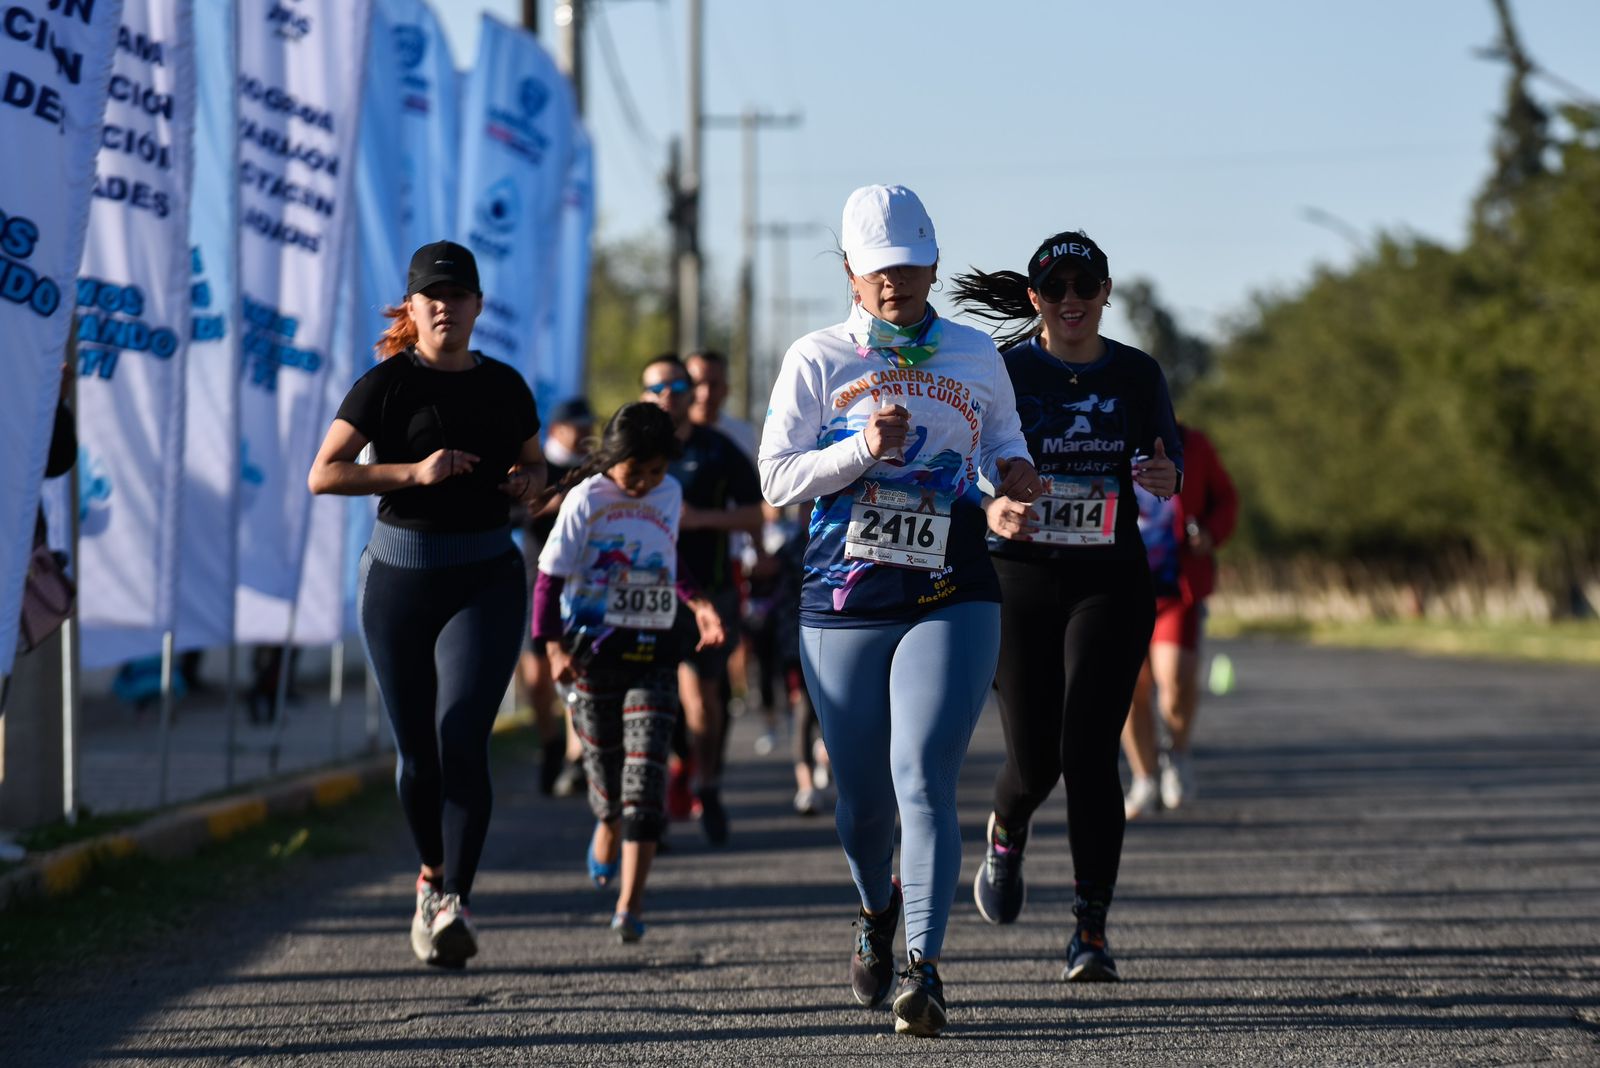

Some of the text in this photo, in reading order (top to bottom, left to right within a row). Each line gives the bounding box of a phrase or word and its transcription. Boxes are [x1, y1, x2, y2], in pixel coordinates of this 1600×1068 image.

[1052, 243, 1092, 260] MEX
[834, 369, 970, 409] GRAN CARRERA 2023
[907, 382, 924, 397] EL
[927, 386, 978, 431] CUIDADO
[1042, 438, 1125, 454] Maraton
[1041, 500, 1103, 528] 1414
[860, 509, 934, 548] 2416
[613, 587, 672, 613] 3038
